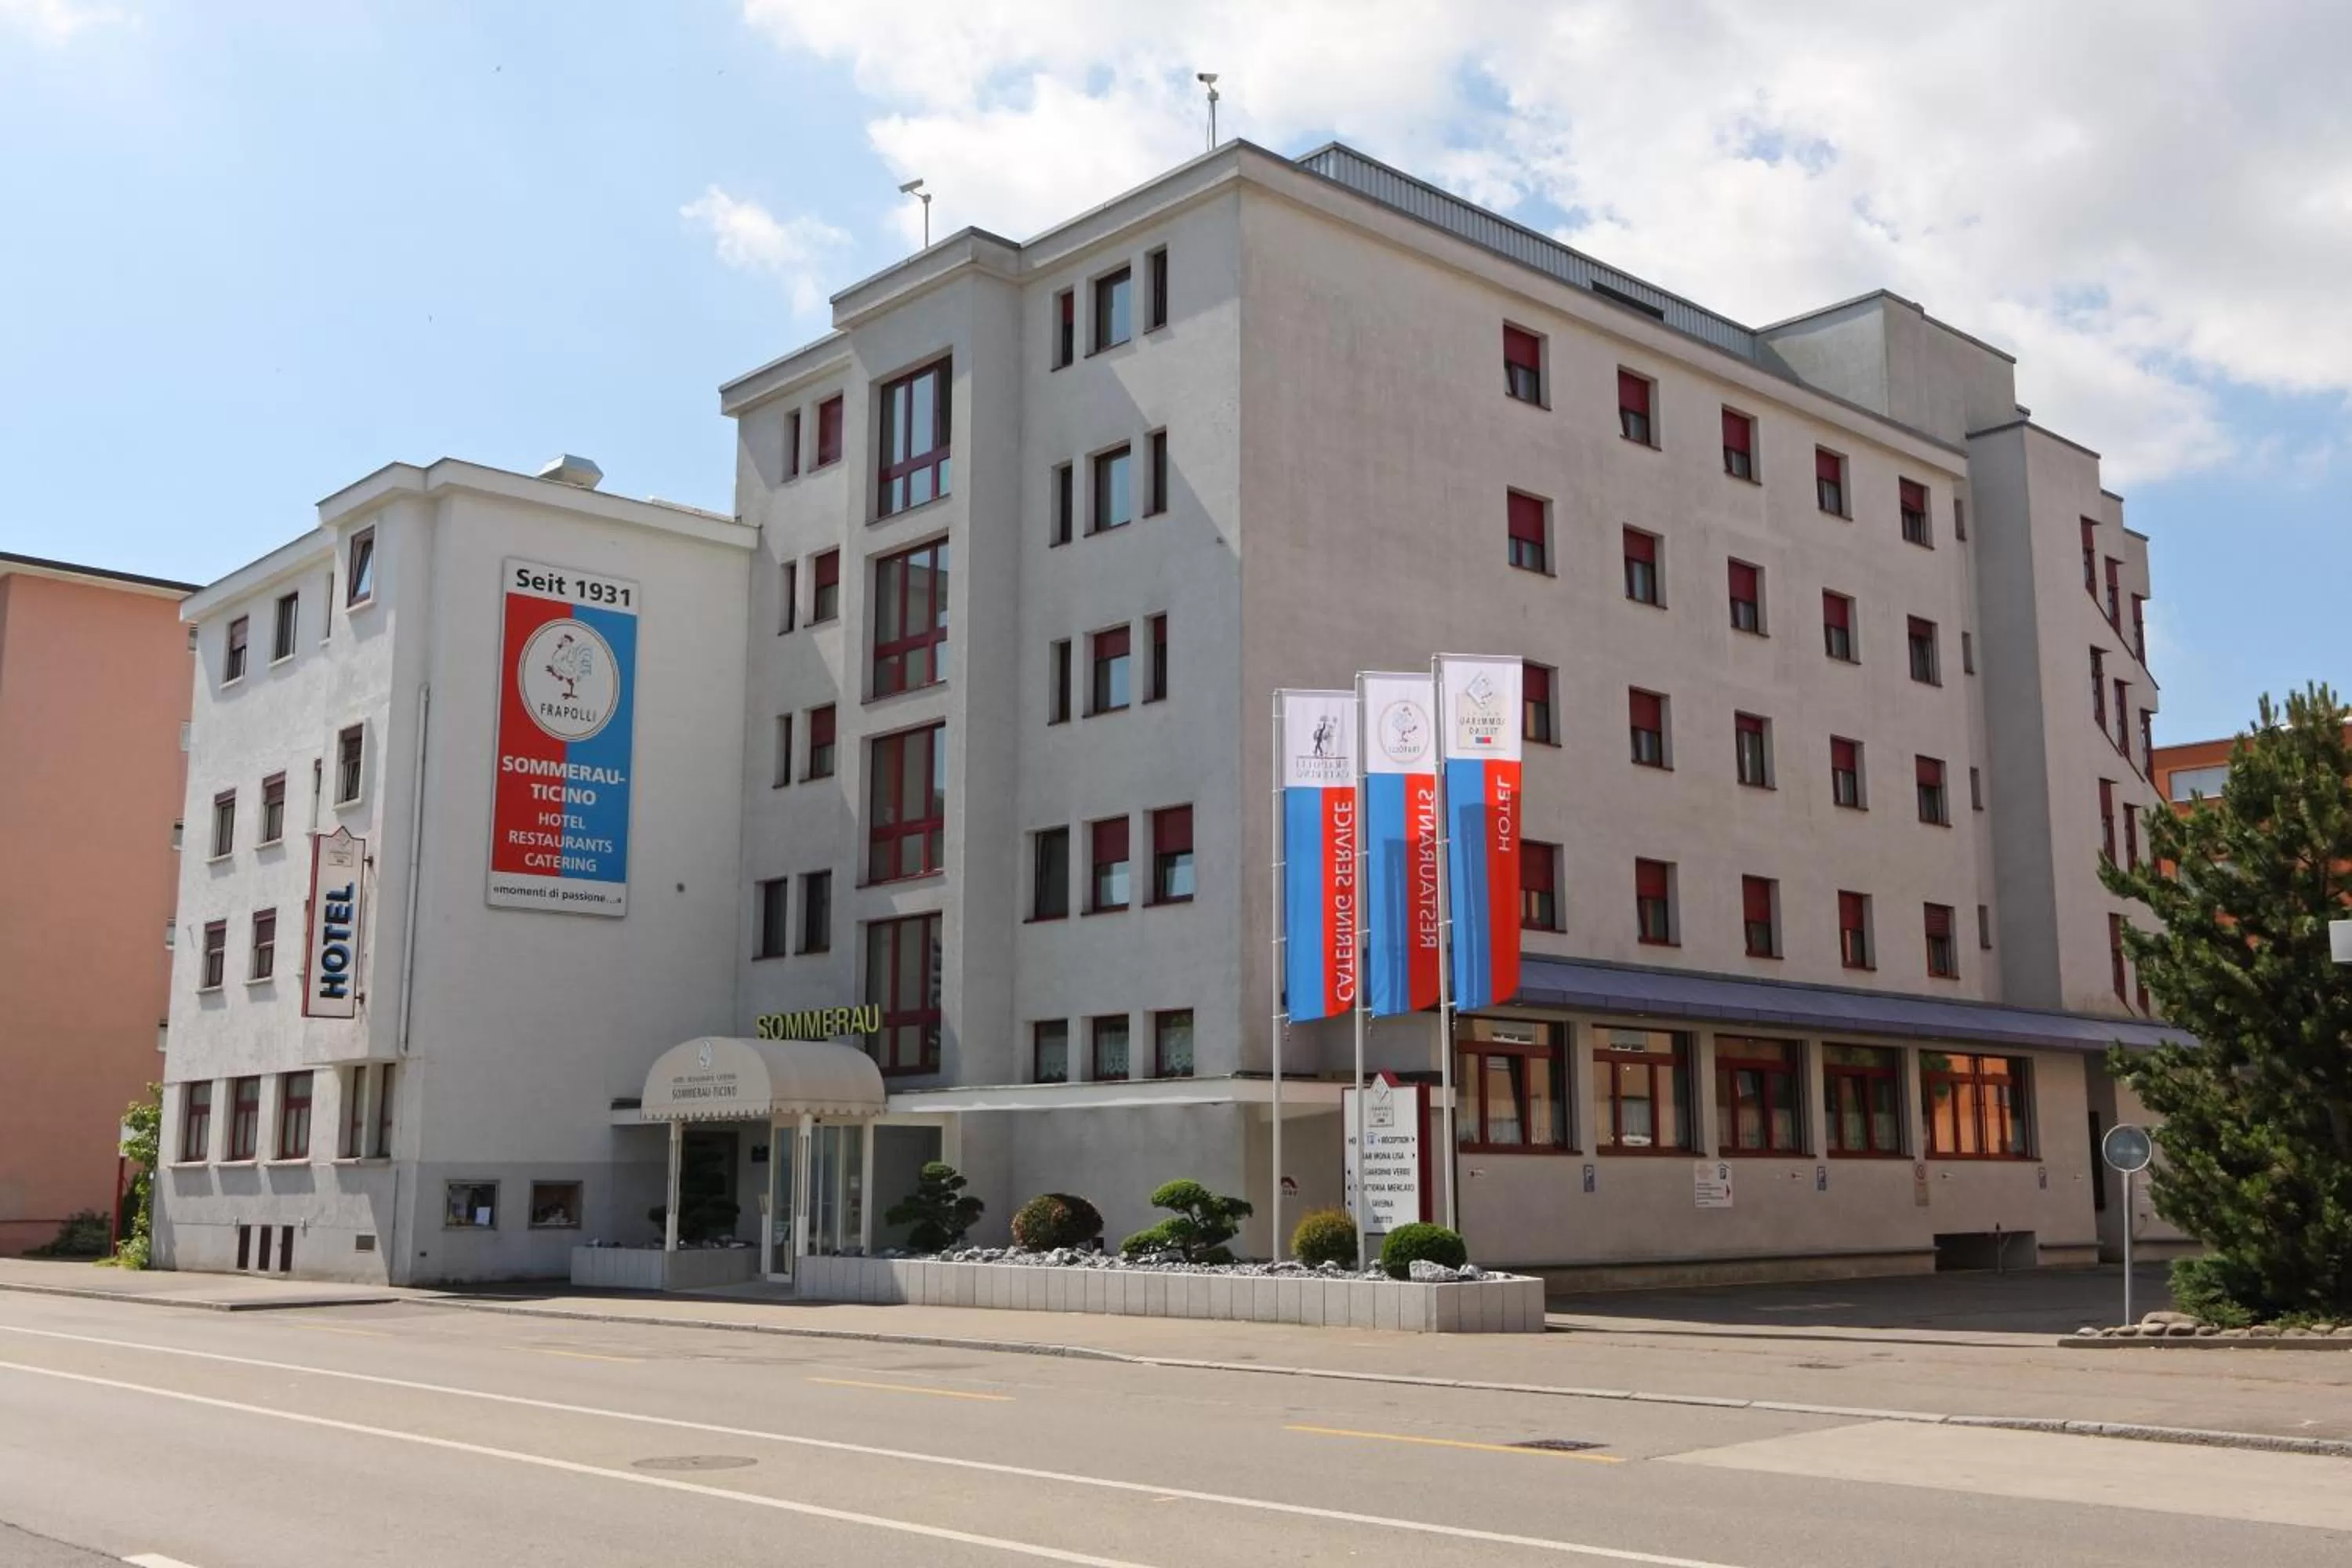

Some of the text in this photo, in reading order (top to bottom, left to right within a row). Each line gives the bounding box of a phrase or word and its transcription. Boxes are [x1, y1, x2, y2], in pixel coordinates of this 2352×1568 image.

[516, 568, 631, 607] Seit 1931
[539, 702, 597, 722] FRAPOLLI
[502, 755, 626, 785] SOMMERAU-
[530, 783, 597, 806] TICINO
[538, 812, 586, 829] HOTEL
[509, 830, 613, 854] RESTAURANTS
[524, 852, 597, 873] CATERING
[549, 888, 559, 898] di
[319, 881, 355, 999] HOTEL
[755, 1003, 880, 1040] SOMMERAU
